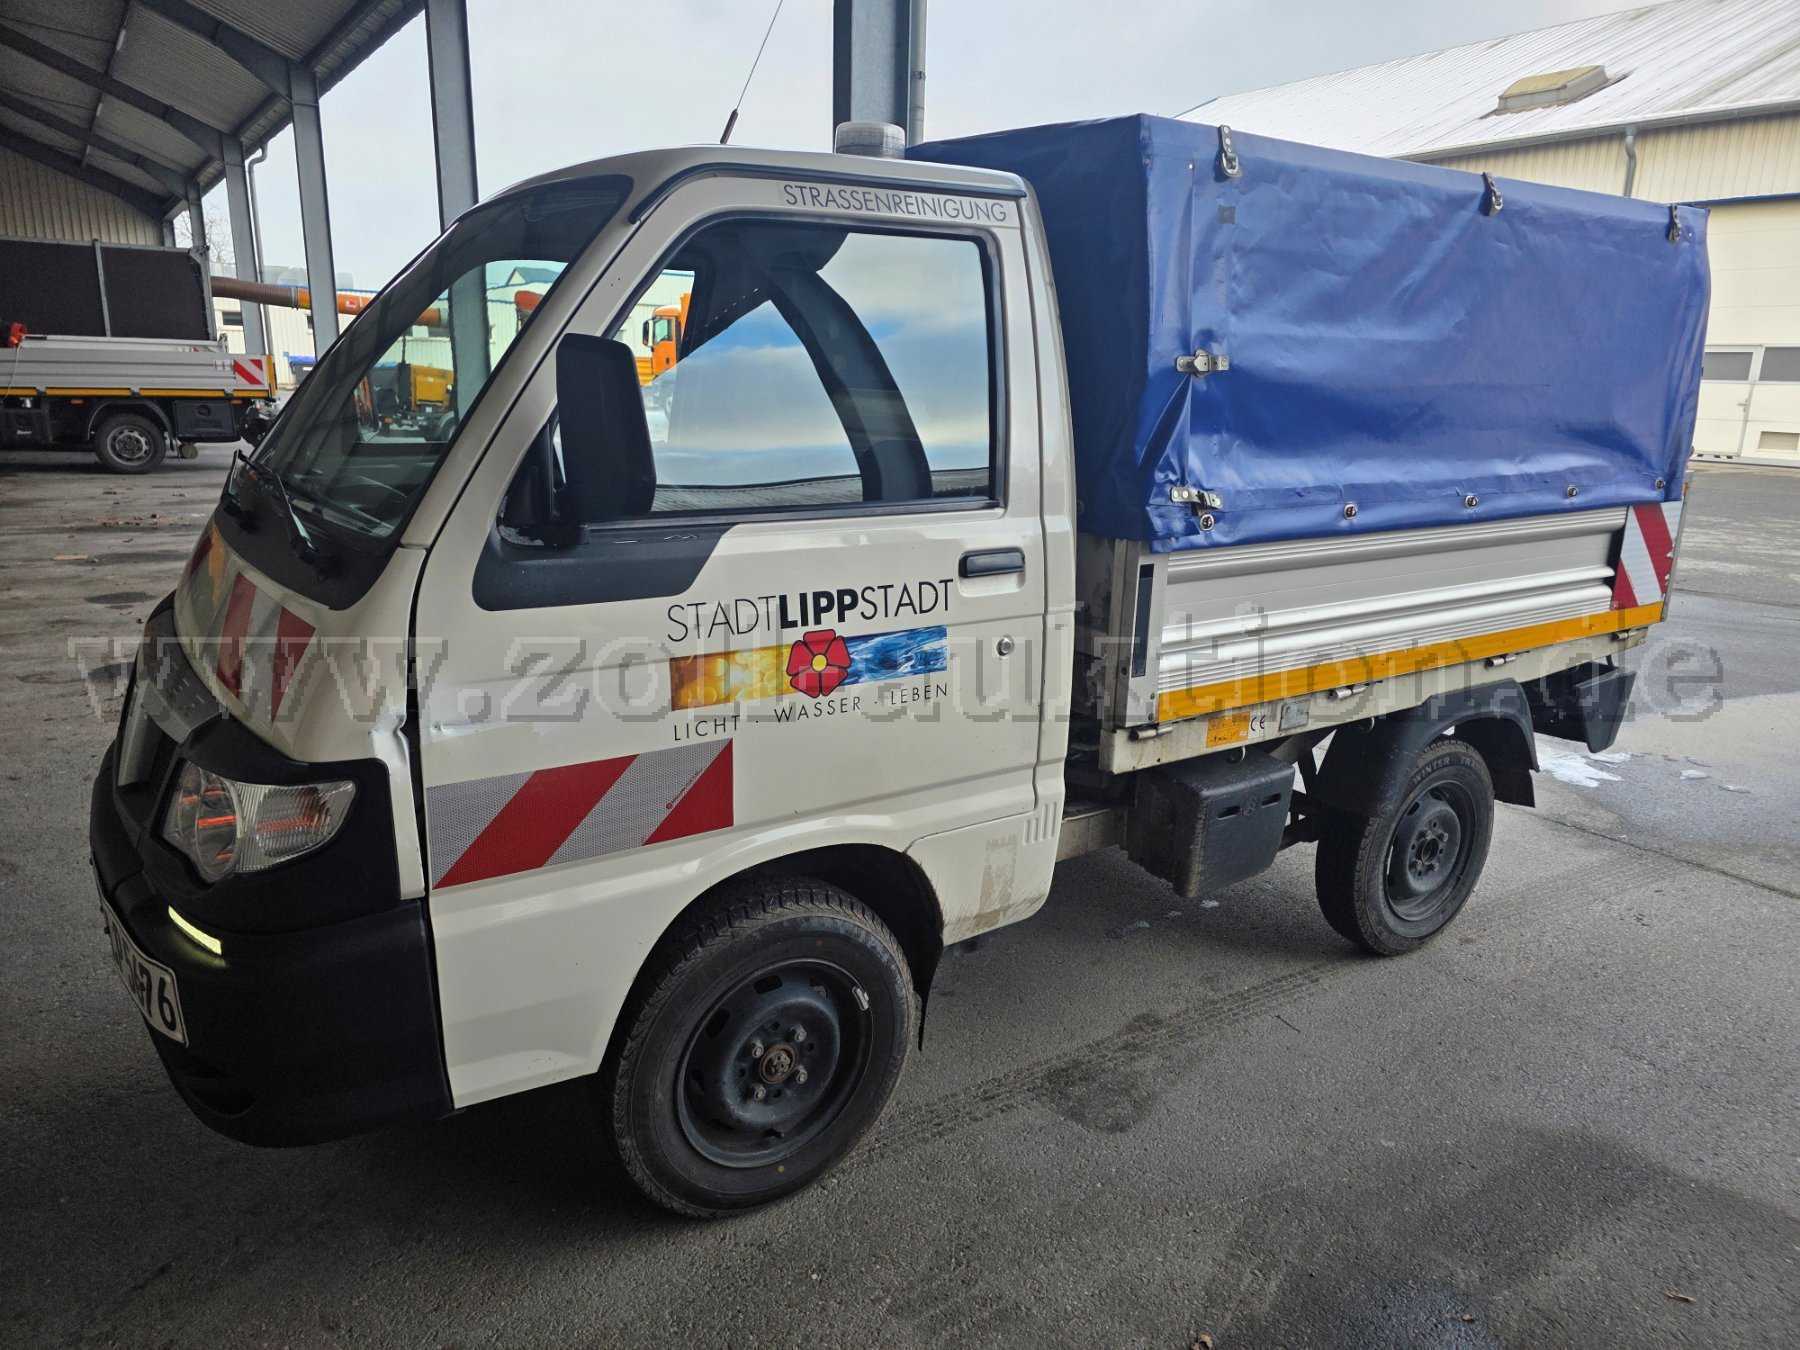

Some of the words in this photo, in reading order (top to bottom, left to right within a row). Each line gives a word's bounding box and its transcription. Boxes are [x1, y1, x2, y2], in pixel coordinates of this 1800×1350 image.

[783, 184, 1007, 222] STRASSENREINIGUNG
[667, 578, 954, 642] STADTLIPPSTADT
[673, 714, 741, 741] LICHT
[773, 696, 862, 723] WASSER
[889, 682, 949, 706] LEBEN
